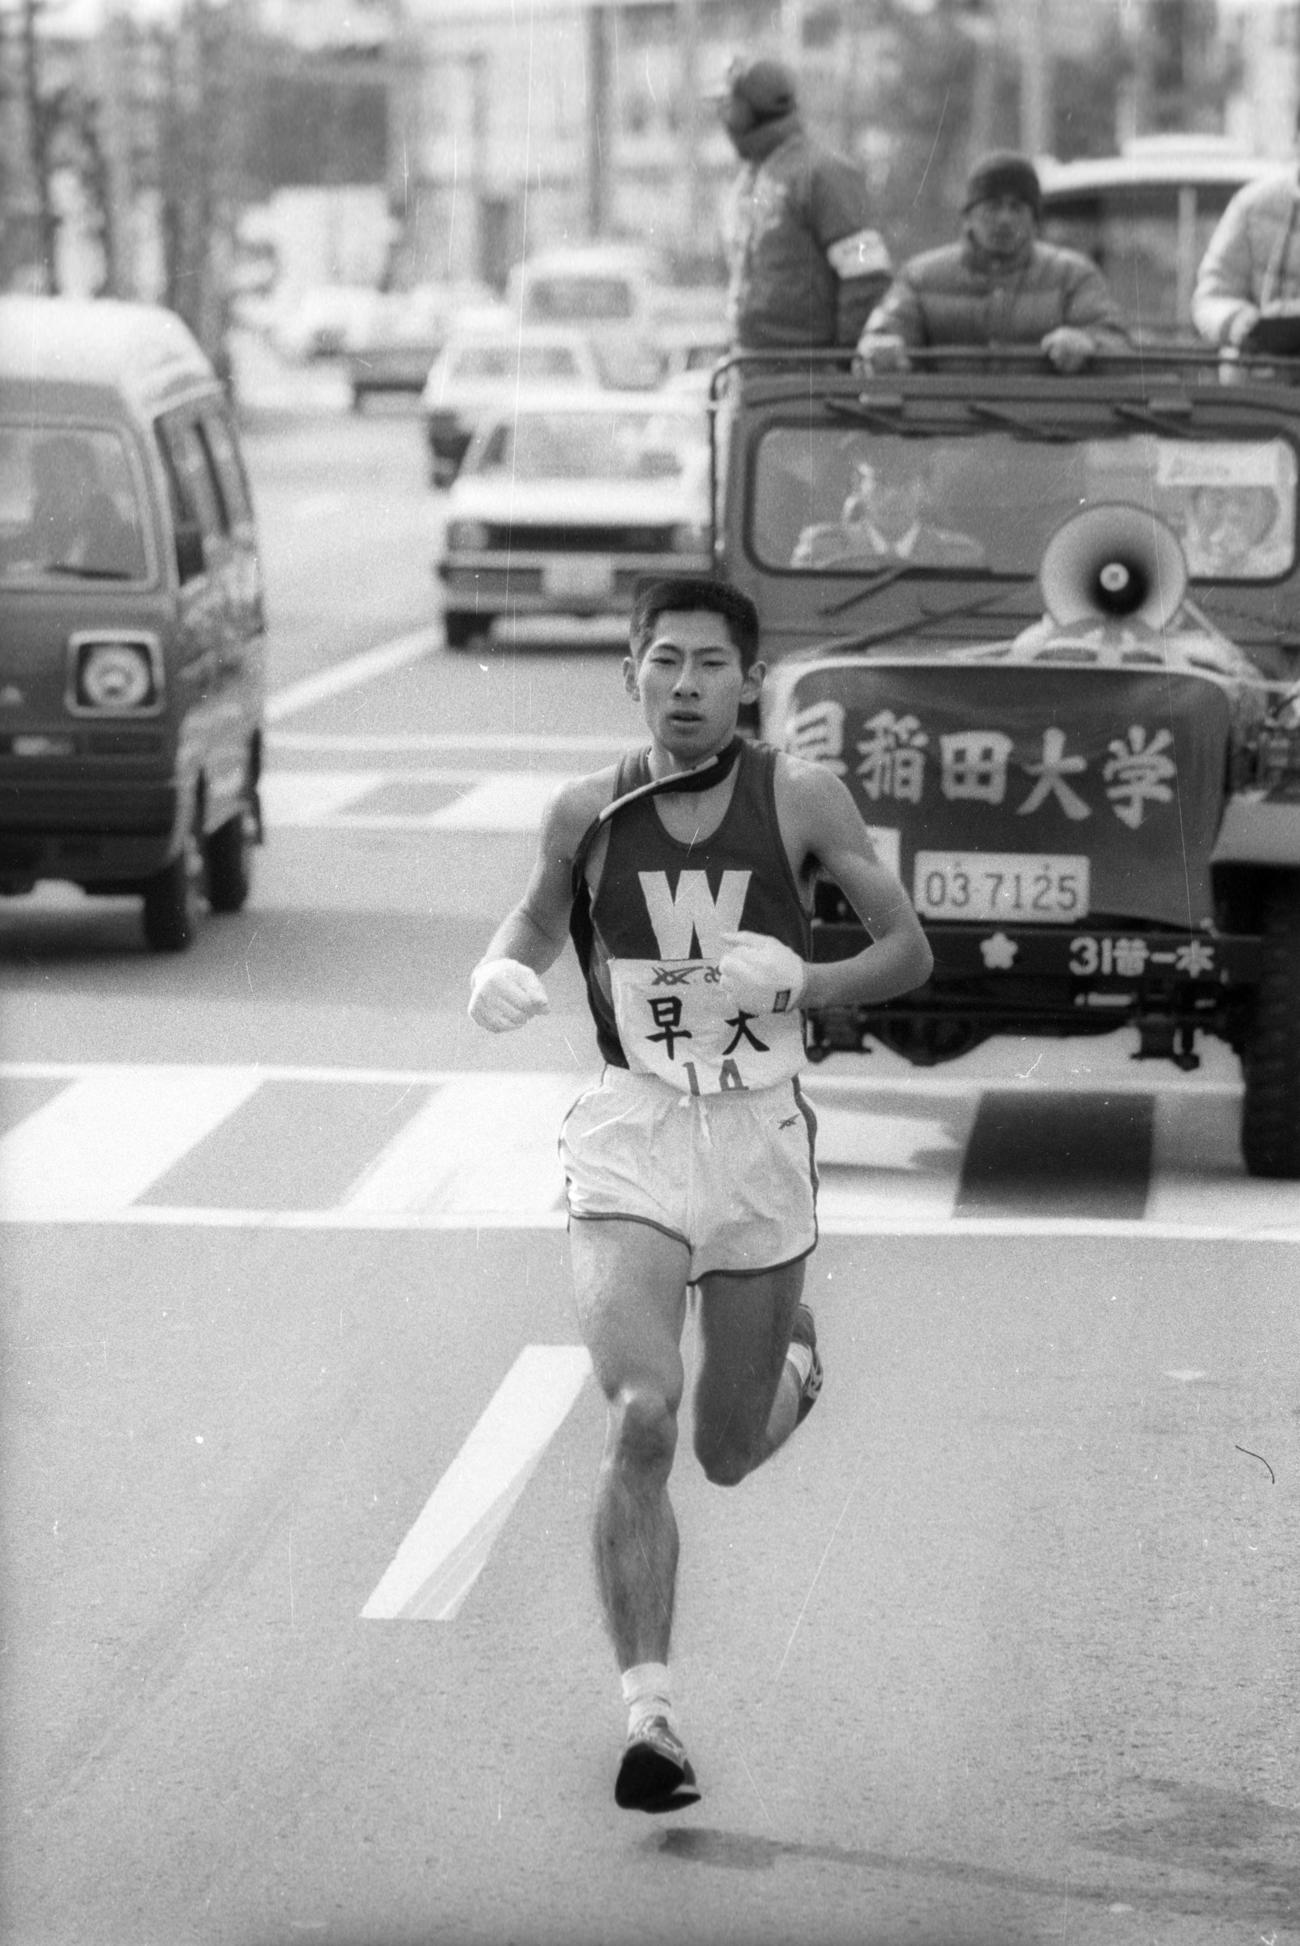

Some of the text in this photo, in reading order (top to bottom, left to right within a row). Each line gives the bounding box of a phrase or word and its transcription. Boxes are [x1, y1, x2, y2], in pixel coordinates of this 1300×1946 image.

[788, 700, 1177, 829] 早稲田大学
[637, 869, 753, 960] W
